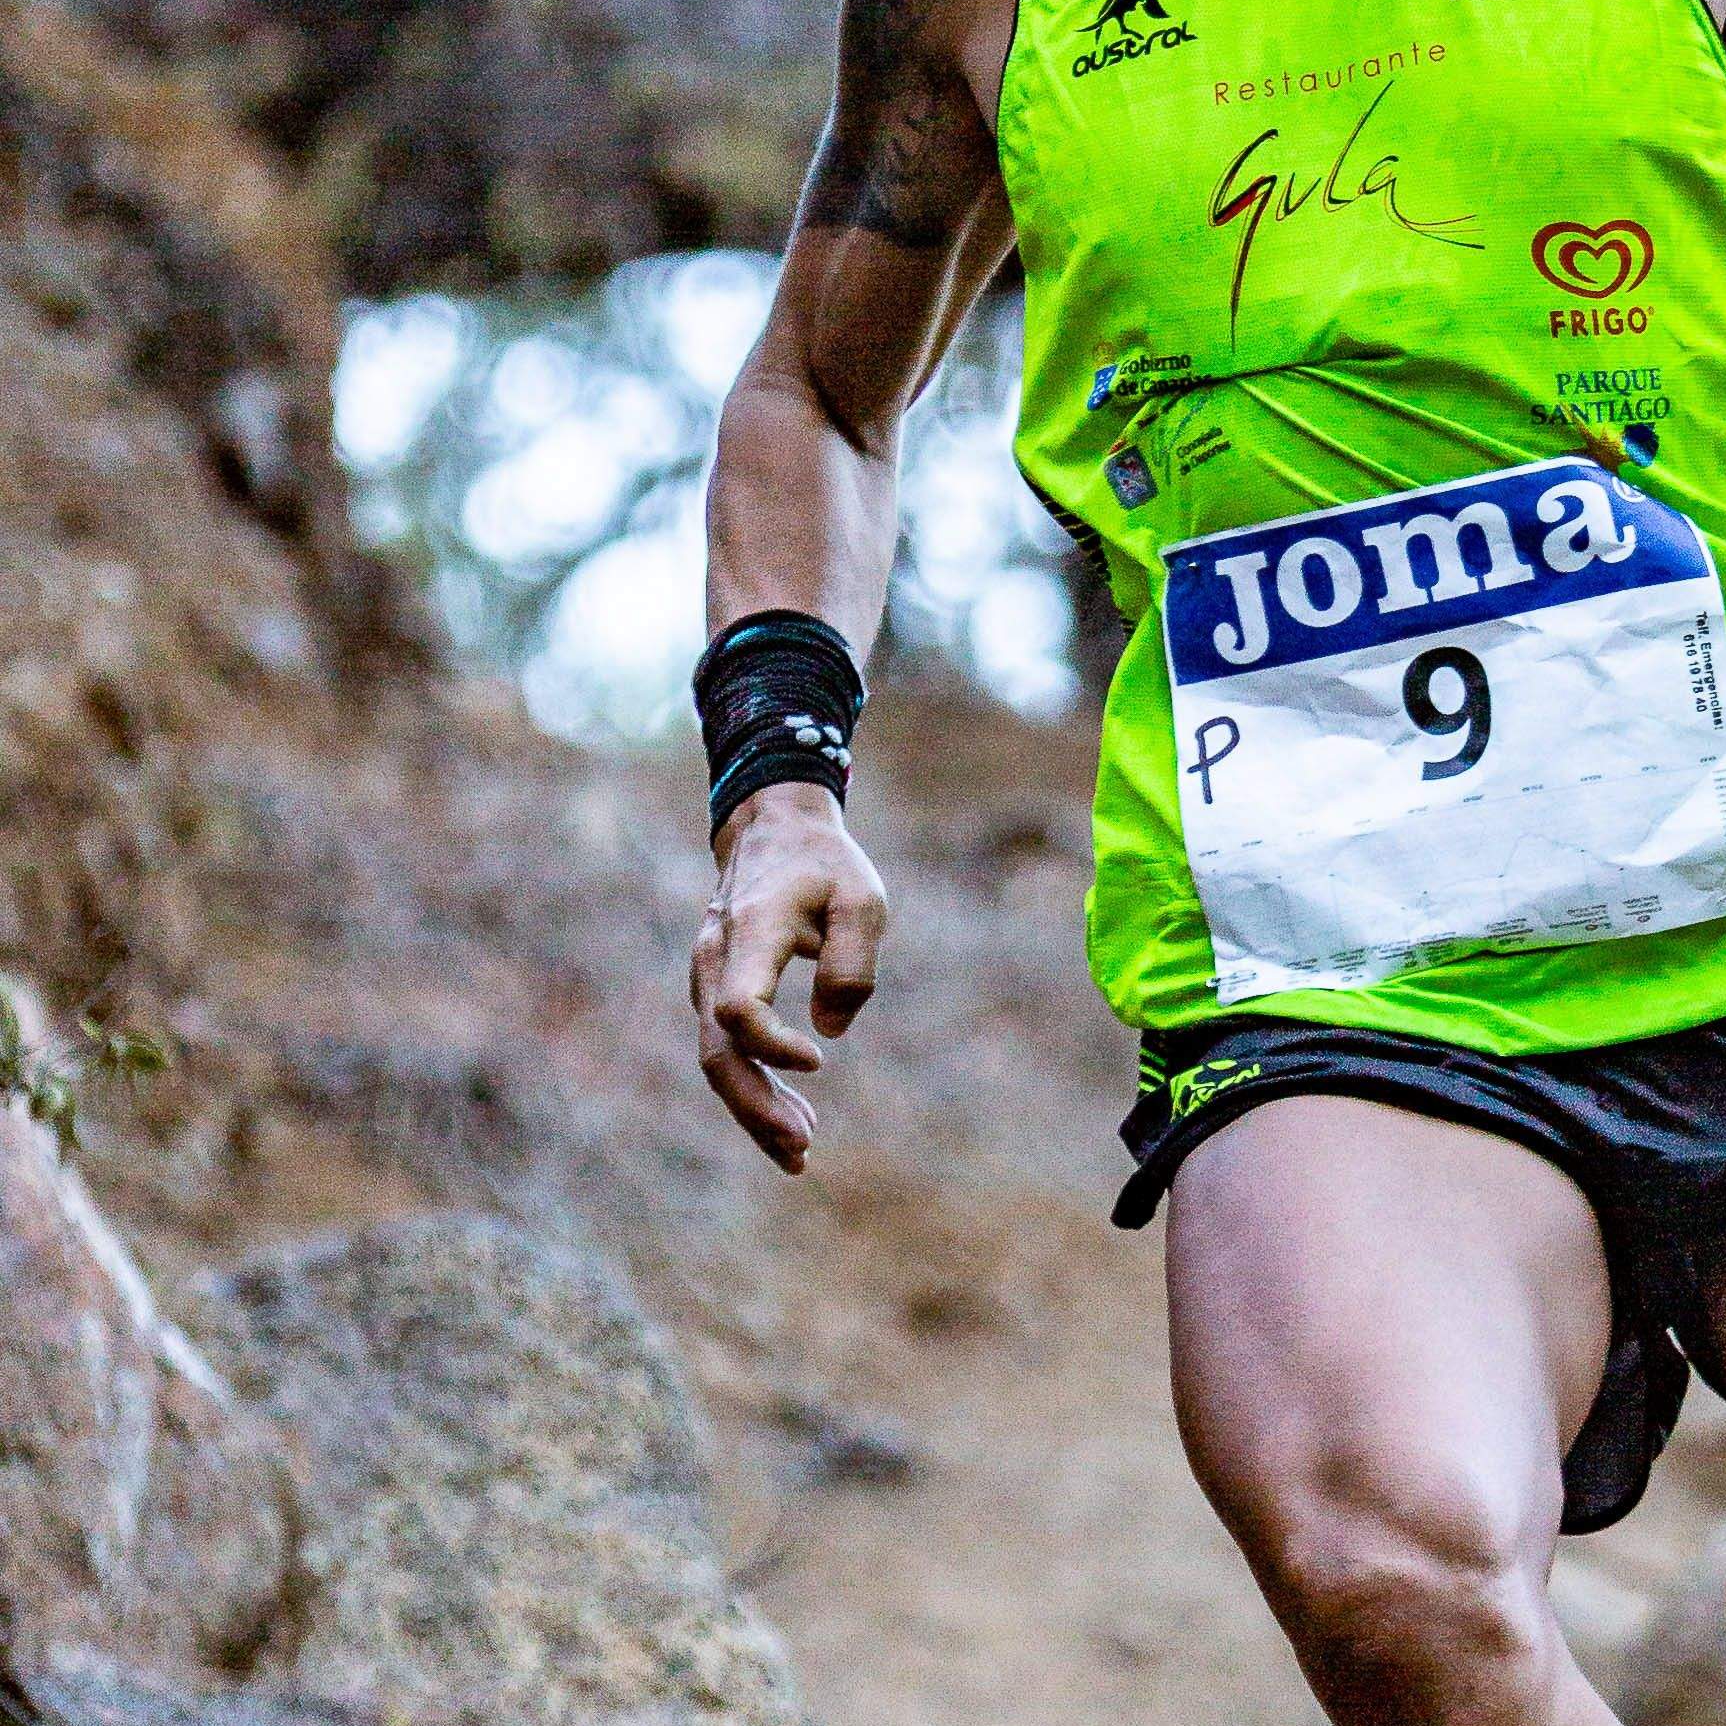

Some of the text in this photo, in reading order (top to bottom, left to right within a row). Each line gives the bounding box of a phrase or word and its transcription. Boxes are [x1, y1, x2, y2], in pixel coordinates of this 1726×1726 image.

[1072, 20, 1198, 78] austral
[1215, 42, 1447, 105] Restaurante
[1550, 306, 1647, 338] FRIGO
[1531, 397, 1671, 425] SANTIAGO
[1555, 368, 1662, 396] PARQUE
[1402, 646, 1493, 781] 9
[1187, 716, 1240, 805] P
